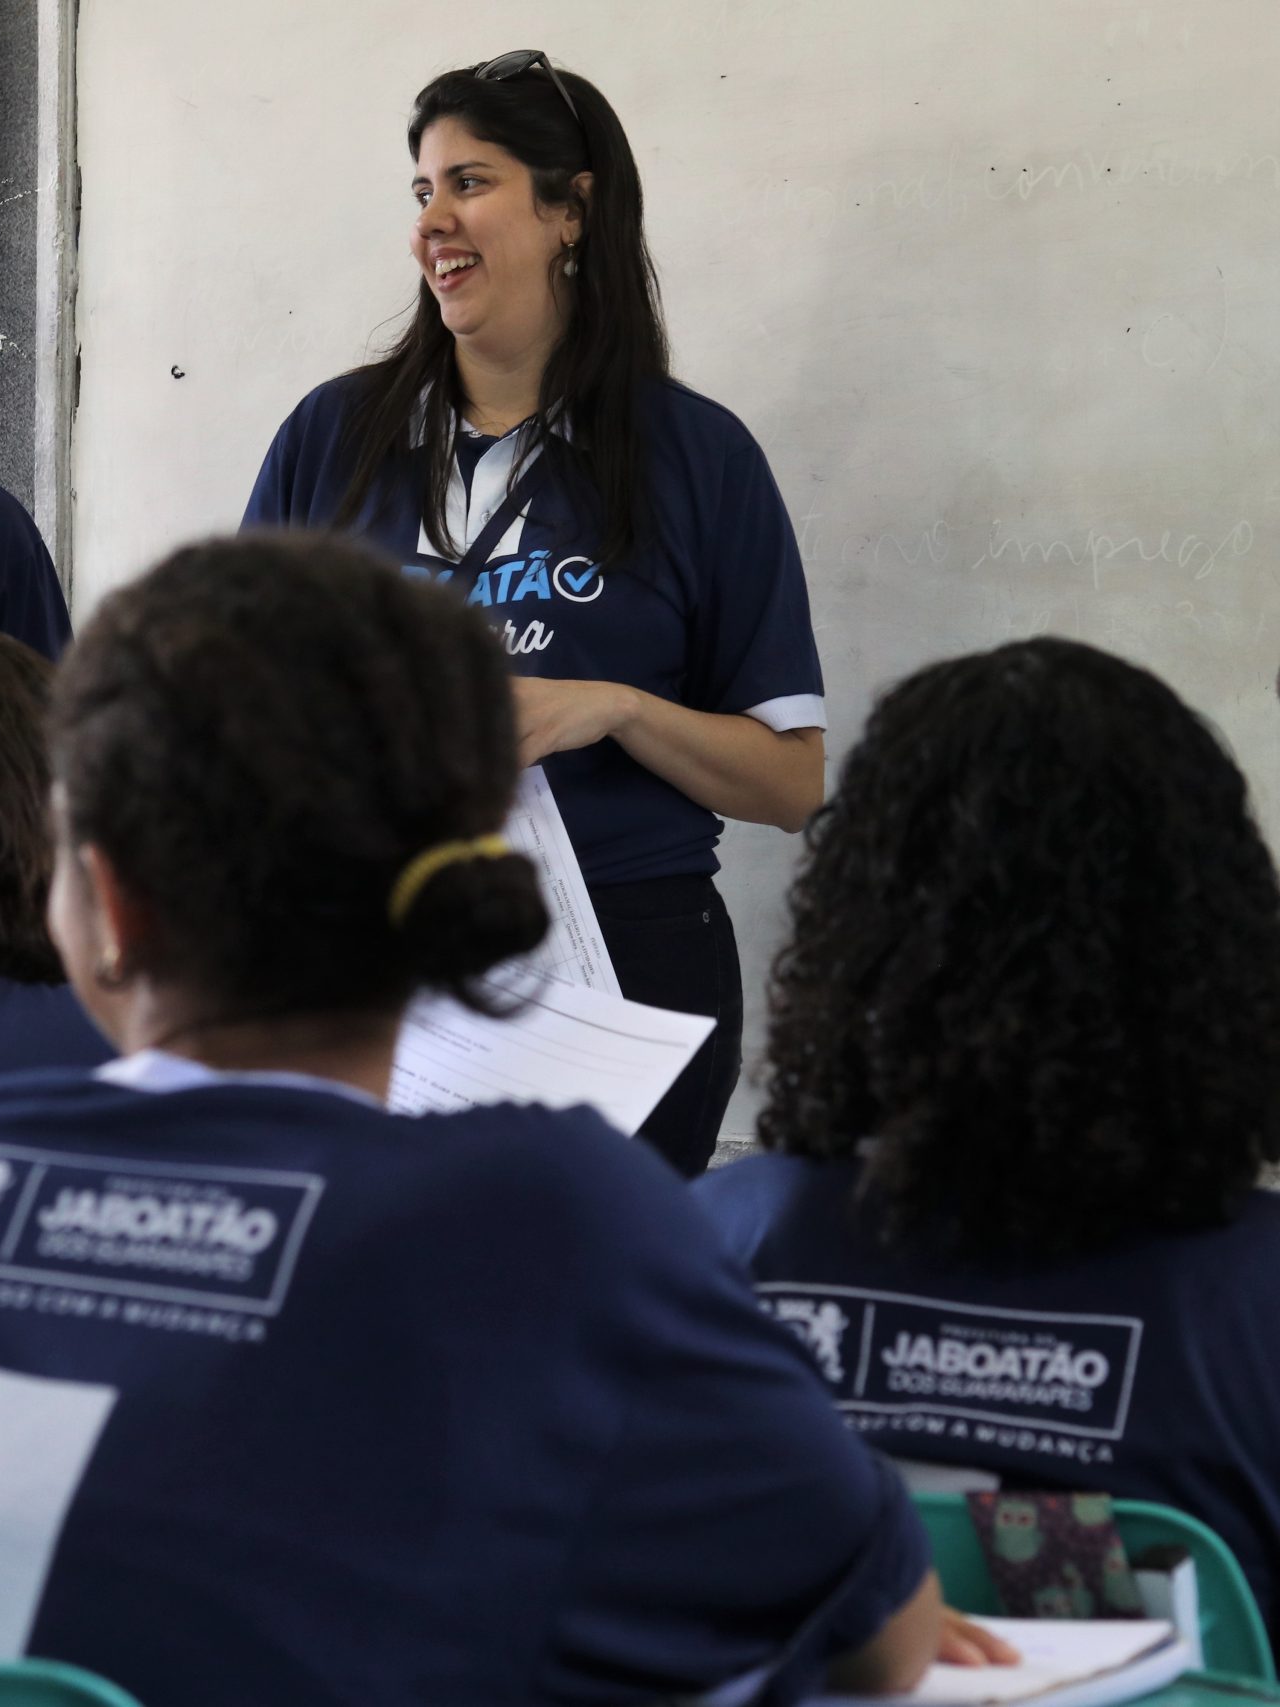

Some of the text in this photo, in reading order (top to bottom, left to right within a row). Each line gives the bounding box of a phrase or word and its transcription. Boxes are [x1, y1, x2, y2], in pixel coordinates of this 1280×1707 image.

[37, 1186, 278, 1255] JABOATÃO
[881, 1330, 1110, 1389] JABOATÃO
[949, 1418, 970, 1439] A
[974, 1422, 1115, 1466] MUDANÇA
